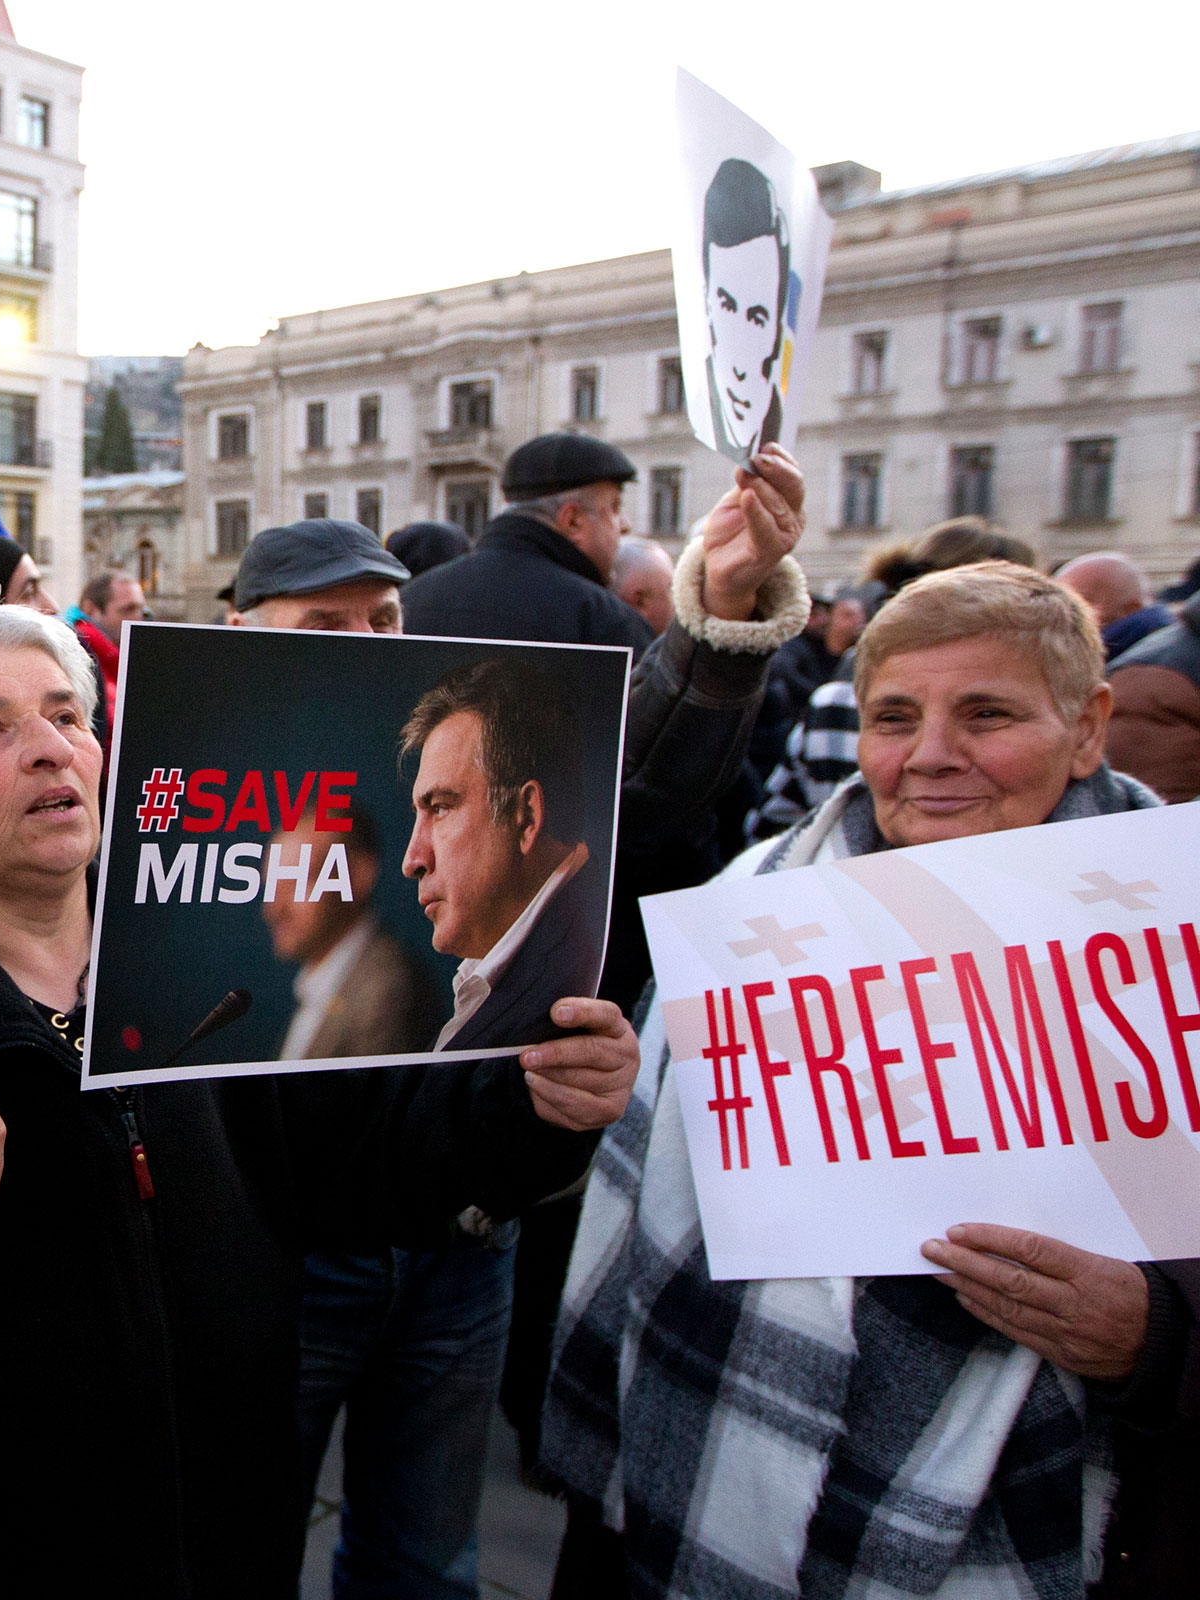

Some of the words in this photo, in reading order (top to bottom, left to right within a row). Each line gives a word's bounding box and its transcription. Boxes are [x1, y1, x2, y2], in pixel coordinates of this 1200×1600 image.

[136, 767, 358, 833] #SAVE
[134, 842, 353, 904] MISHA
[702, 922, 1200, 1171] #FREEMISH
